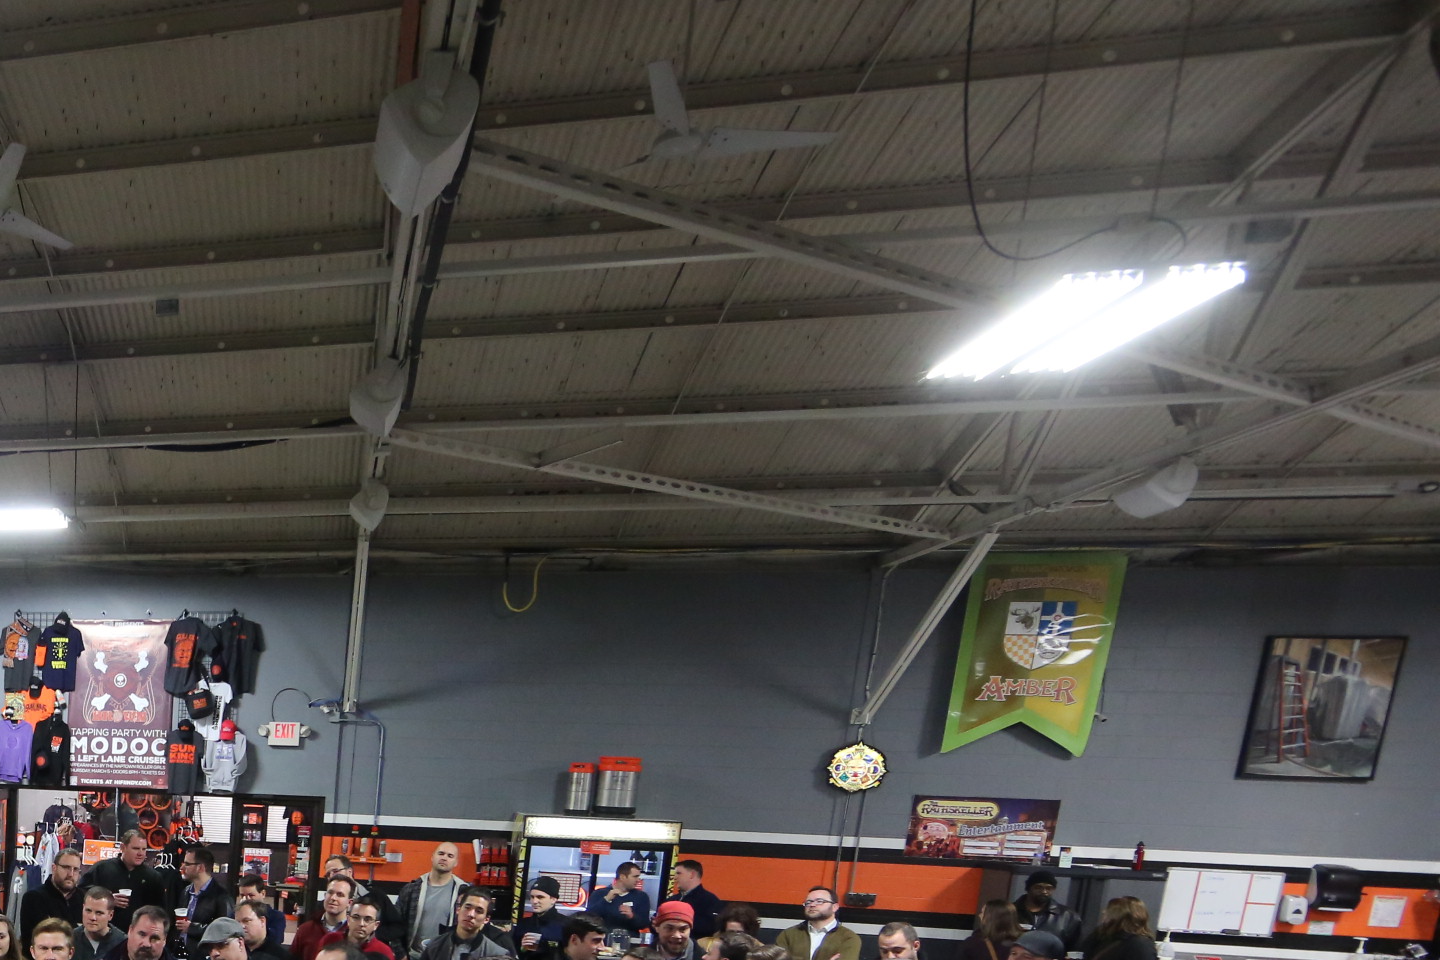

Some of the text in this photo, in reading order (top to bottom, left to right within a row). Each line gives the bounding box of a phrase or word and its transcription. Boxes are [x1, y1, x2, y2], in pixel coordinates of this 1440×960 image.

[974, 675, 1078, 705] AMBER
[71, 727, 167, 738] TAPPING PARTY WITH
[274, 723, 297, 739] EXIT
[70, 737, 167, 756] MODOC
[169, 743, 196, 753] SUN
[77, 755, 101, 763] LEFT
[101, 755, 126, 764] LANE
[128, 756, 166, 765] CRUISER
[957, 820, 1045, 837] Entertainment
